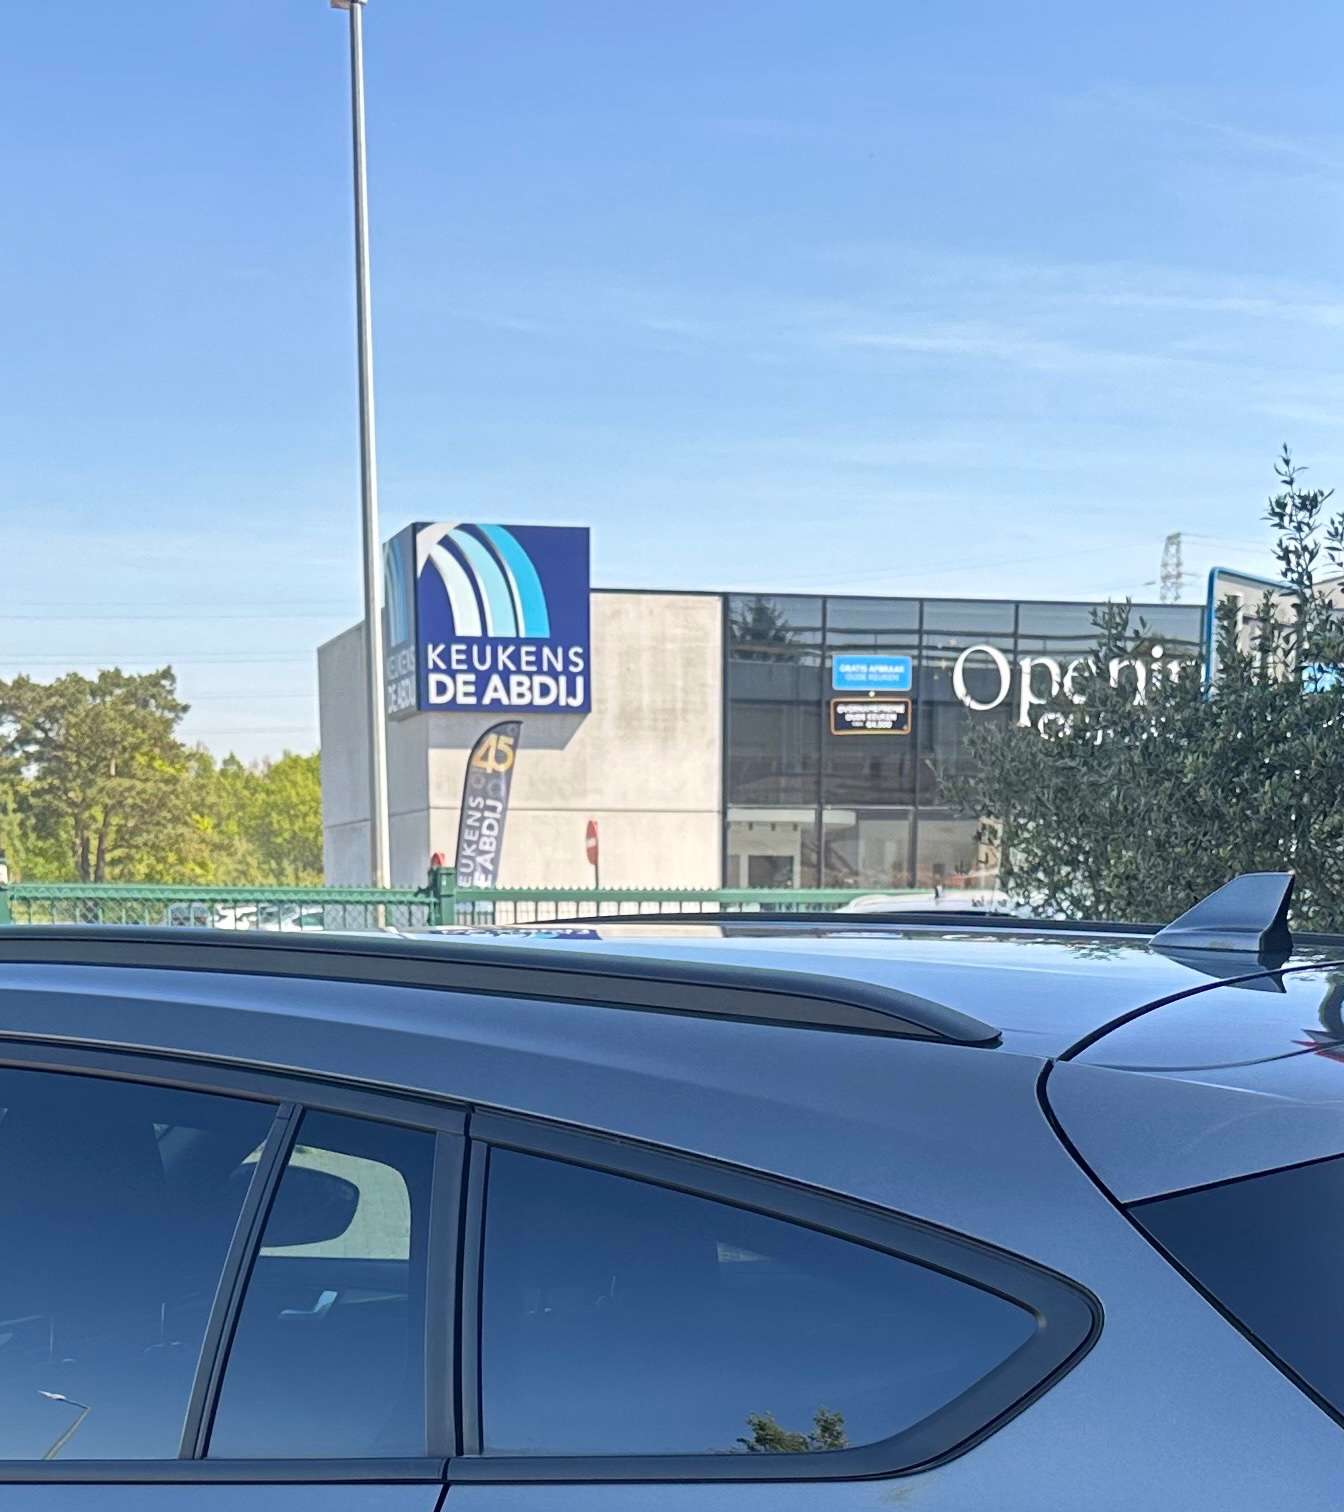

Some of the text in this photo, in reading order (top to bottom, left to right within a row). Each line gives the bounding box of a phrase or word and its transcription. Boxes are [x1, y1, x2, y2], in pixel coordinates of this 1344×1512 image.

[426, 643, 586, 673] KEUKENS
[427, 673, 478, 705] DE
[481, 673, 586, 708] ABDIJ
[471, 733, 516, 774] 45
[457, 795, 485, 889] EUKENS
